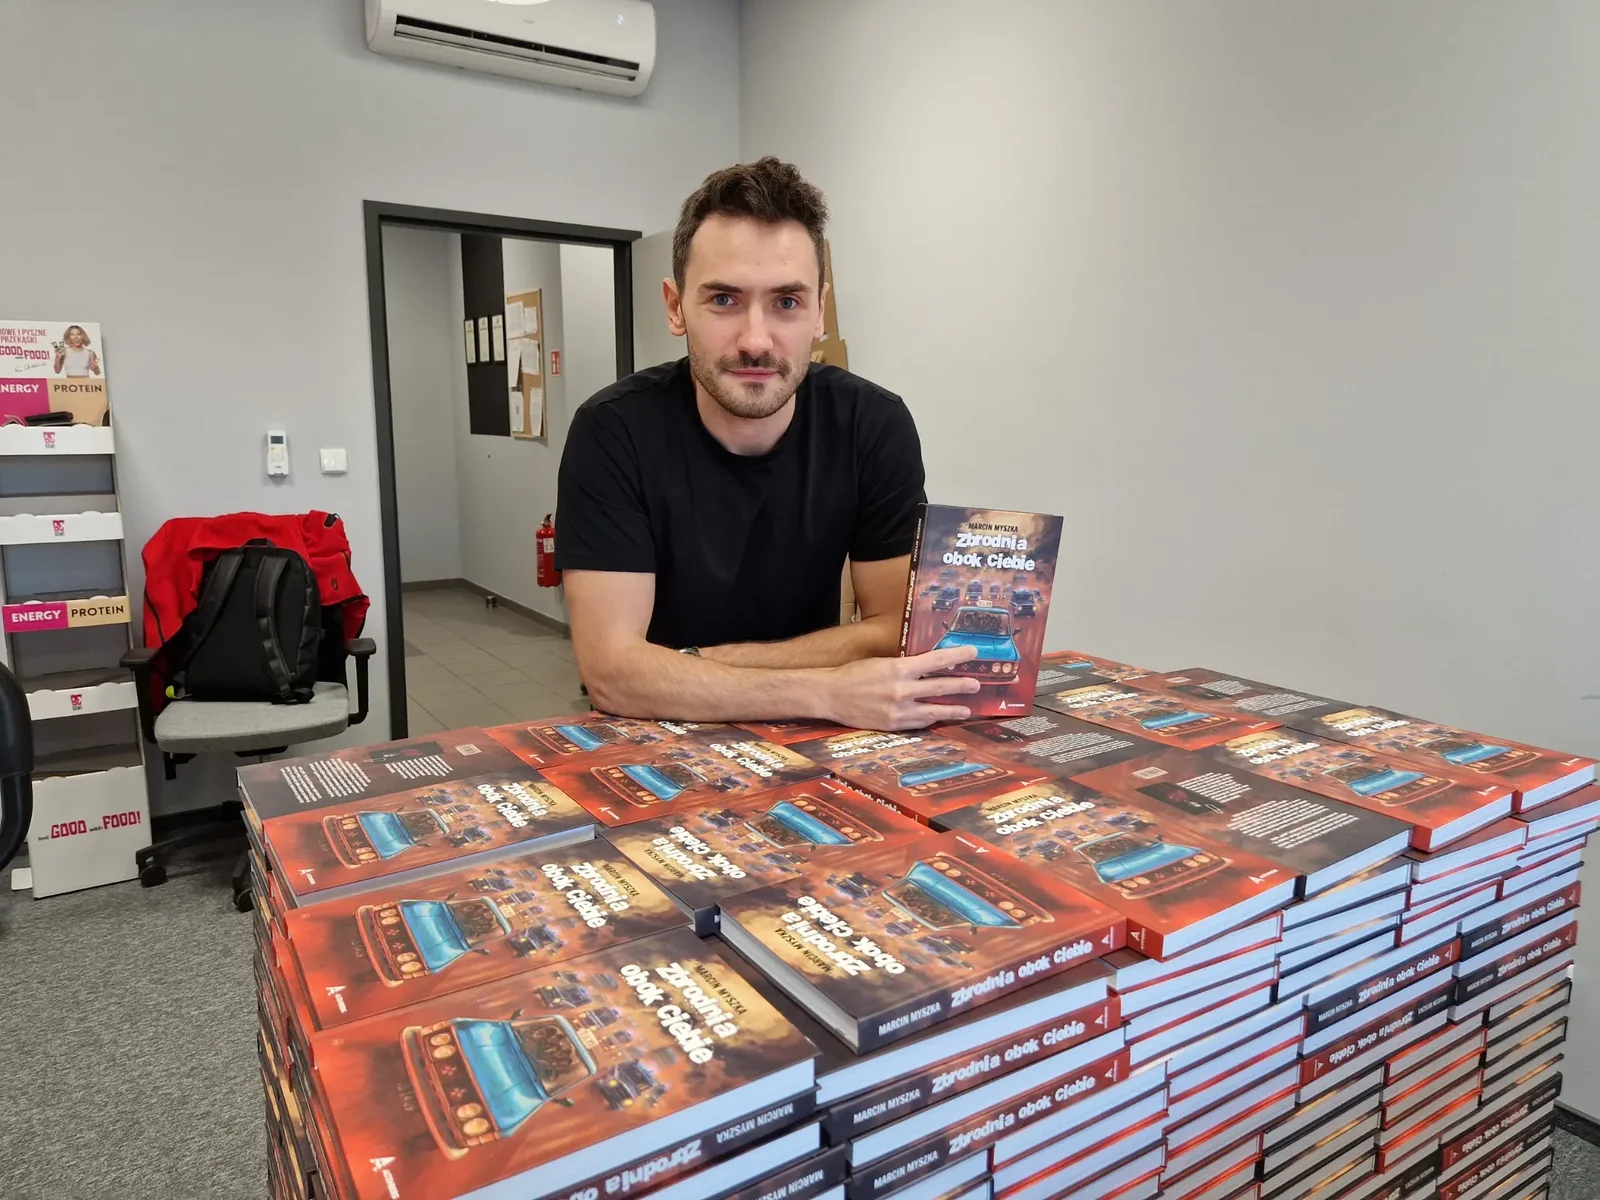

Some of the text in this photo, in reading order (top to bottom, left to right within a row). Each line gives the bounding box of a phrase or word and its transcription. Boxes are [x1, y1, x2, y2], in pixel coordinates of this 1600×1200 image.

[54, 384, 102, 392] PROTEIN
[956, 532, 1028, 550] Zbrodnia
[994, 524, 1018, 532] MYSZKA
[943, 551, 1036, 571] obok Ciebie
[12, 610, 61, 623] ENERGY
[71, 605, 124, 617] PROTEIN
[710, 743, 772, 777] obok Ciebie
[732, 742, 785, 768] Zbrodnia
[477, 784, 530, 827] obok Ciebie
[501, 783, 547, 817] Zbrodnia
[986, 796, 1066, 824] Zbrodnia
[51, 820, 87, 839] GOOD
[102, 811, 141, 829] FOOD!
[996, 801, 1096, 835] obok Ciebie
[651, 837, 718, 880] Zbrodnia
[669, 826, 747, 879] obok Ciebie
[541, 863, 608, 928] obok Ciebie
[570, 862, 629, 912] Zbrodnia
[620, 879, 640, 896] MYSZKA
[774, 928, 834, 973] MARCIN MYSZKA
[781, 911, 872, 976] Zbrodnia
[797, 895, 906, 974] obok Ciebie
[694, 965, 747, 1015] MARCIN MYSZKA
[878, 1013, 910, 1036] MARCIN
[910, 1002, 941, 1025] MYSZKA
[951, 970, 1015, 1008] Zbrodnia
[1018, 955, 1051, 978] obok
[1053, 939, 1093, 964] Ciebie
[1358, 977, 1395, 1003] Zbrodnia
[1396, 966, 1415, 982] obok
[1416, 954, 1440, 972] Ciebie
[620, 964, 714, 1064] obok Ciebie
[655, 961, 739, 1039] Zbrodnia
[1357, 1032, 1377, 1049] obok
[1379, 1011, 1414, 1036] Zbrodnia
[853, 1105, 887, 1125] MARCIN
[887, 1088, 921, 1110] MYSZKA
[932, 1054, 1001, 1094] Zbrodnia
[1004, 1038, 1041, 1062] obok
[1042, 1020, 1086, 1047] Ciebie
[716, 1119, 755, 1143] MYSZKA
[757, 1102, 794, 1126] MARCIN
[874, 1168, 906, 1190] MARCIN
[905, 1151, 938, 1173] MYSZKA
[948, 1111, 1014, 1154] Zbrodnia
[1018, 1095, 1052, 1120] obok
[1054, 1075, 1097, 1102] Ciebie
[605, 1139, 702, 1194] Zbrodnia
[788, 1169, 824, 1194] MARCIN
